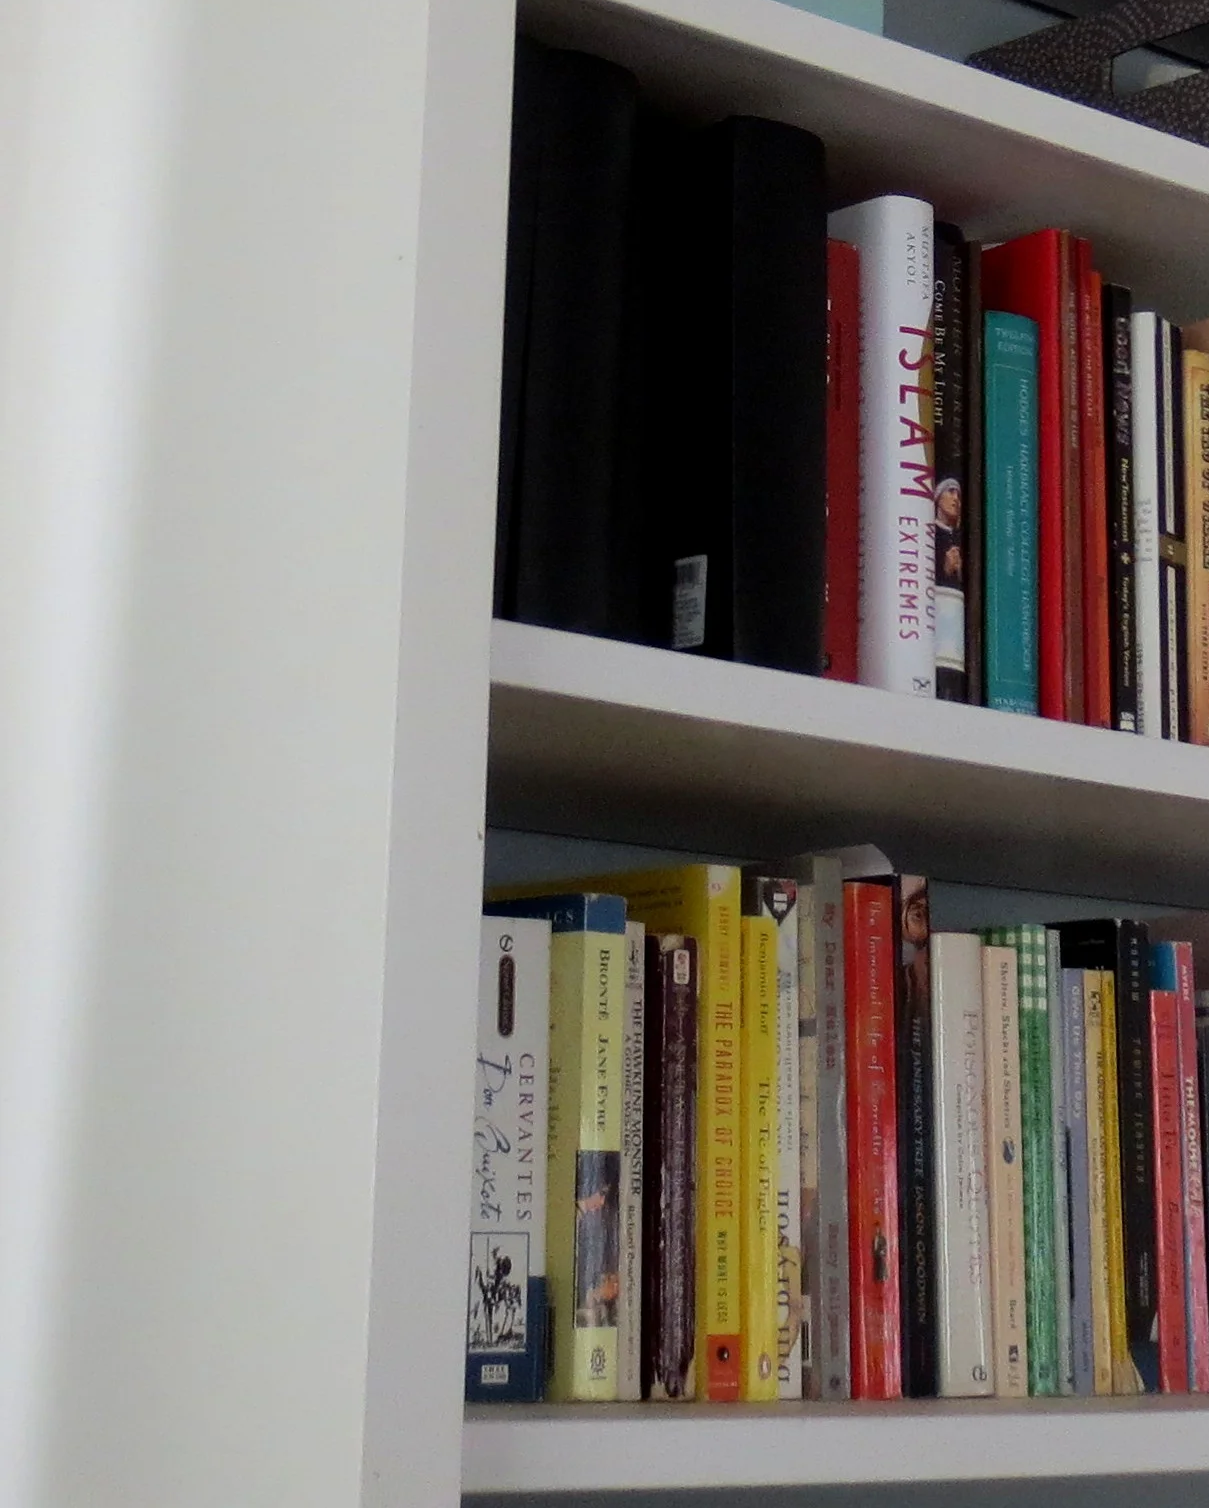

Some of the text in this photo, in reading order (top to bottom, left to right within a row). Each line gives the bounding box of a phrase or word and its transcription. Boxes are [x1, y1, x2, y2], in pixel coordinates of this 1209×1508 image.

[905, 232, 916, 288] AKYOL
[933, 279, 947, 428] COME BE MY LIGHT
[897, 325, 937, 503] ISLAM
[898, 515, 919, 642] EXTREMES
[925, 521, 937, 638] WITHOUT
[868, 900, 882, 926] The
[632, 998, 643, 1028] THE
[757, 931, 770, 1037] Benjamin Hoff
[869, 934, 883, 1006] Immortal
[597, 1033, 610, 1079] JANE
[867, 1054, 884, 1075] of
[516, 1052, 536, 1222] CERVANTES
[596, 1084, 610, 1134] EYRE
[714, 1001, 733, 1220] THE PARADOX OF CHOICE
[630, 1119, 643, 1196] MONSTER
[756, 1077, 771, 1236] The Te of Piglet
